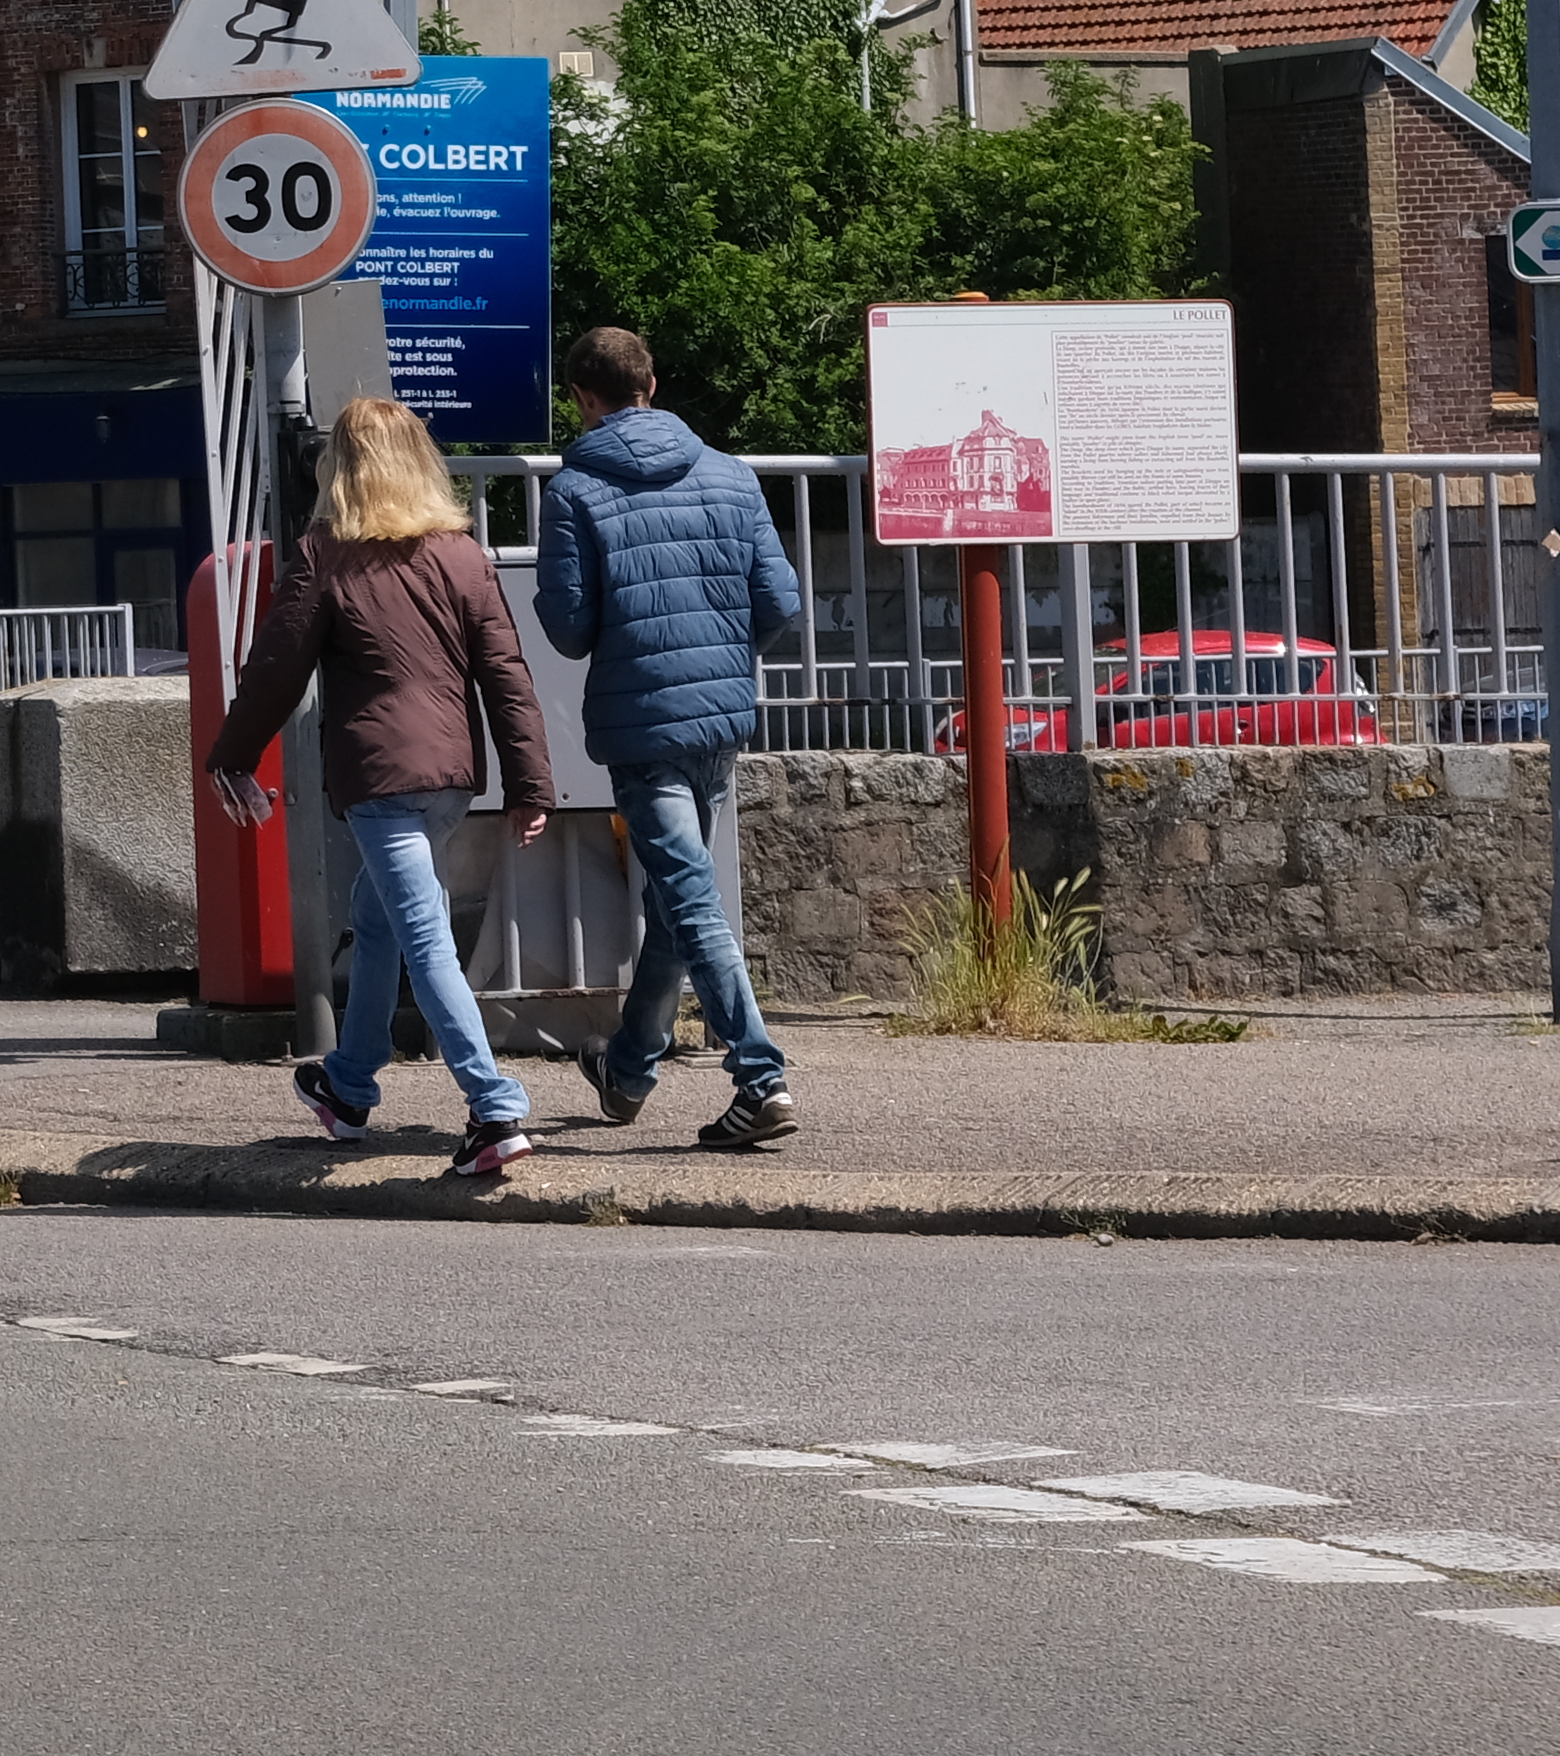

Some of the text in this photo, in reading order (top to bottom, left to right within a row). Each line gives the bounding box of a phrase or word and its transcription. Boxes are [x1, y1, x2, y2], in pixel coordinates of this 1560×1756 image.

[336, 92, 451, 109] NORMANDIE
[379, 143, 529, 171] COLBERT
[224, 161, 332, 234] 30
[402, 193, 456, 204] attention
[393, 205, 441, 218] évacuez
[443, 206, 501, 220] l'ouvrage.
[409, 247, 426, 258] les
[429, 247, 476, 259] horaires
[478, 247, 494, 259] du
[355, 261, 460, 273] PONT COLBERT
[433, 278, 452, 286] sur
[1172, 309, 1228, 321] LE POLLET
[415, 336, 466, 350] sécurité,
[404, 352, 423, 362] est
[426, 353, 453, 362] sous
